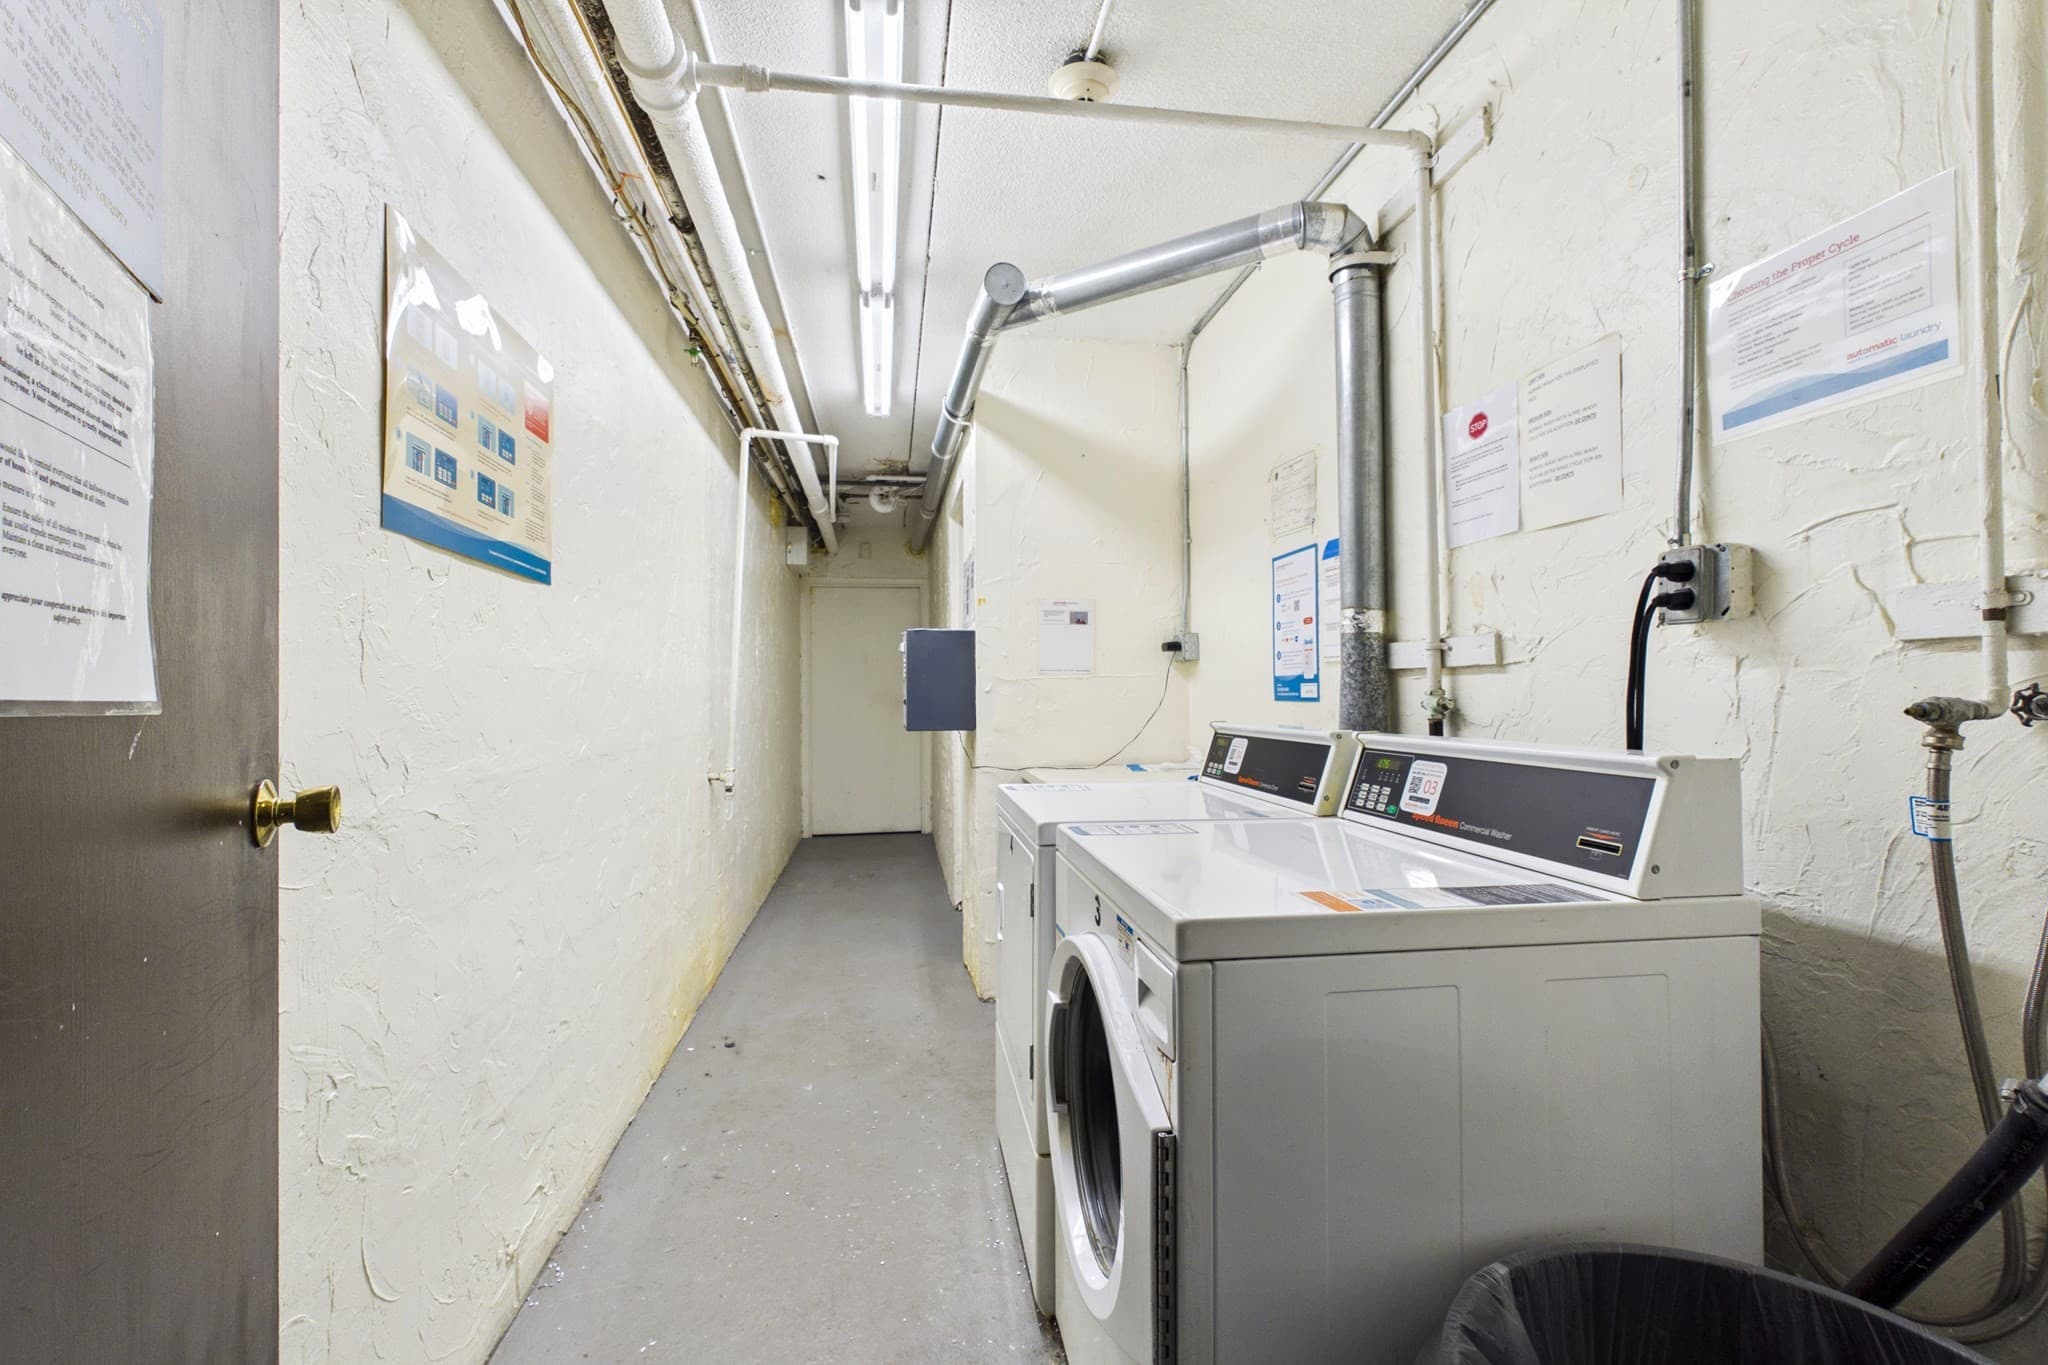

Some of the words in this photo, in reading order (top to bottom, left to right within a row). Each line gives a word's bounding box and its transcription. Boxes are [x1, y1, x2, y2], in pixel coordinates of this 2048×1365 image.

[1772, 267, 1788, 281] the
[1791, 250, 1825, 272] Proper
[1828, 233, 1860, 254] Cycle
[1846, 337, 1897, 360] automatic
[1900, 321, 1941, 341] laundry
[1470, 419, 1487, 433] STOP
[1423, 779, 1439, 795] 03
[1460, 821, 1490, 836] Commercial
[1490, 828, 1513, 841] Washer
[1095, 894, 1101, 927] 3
